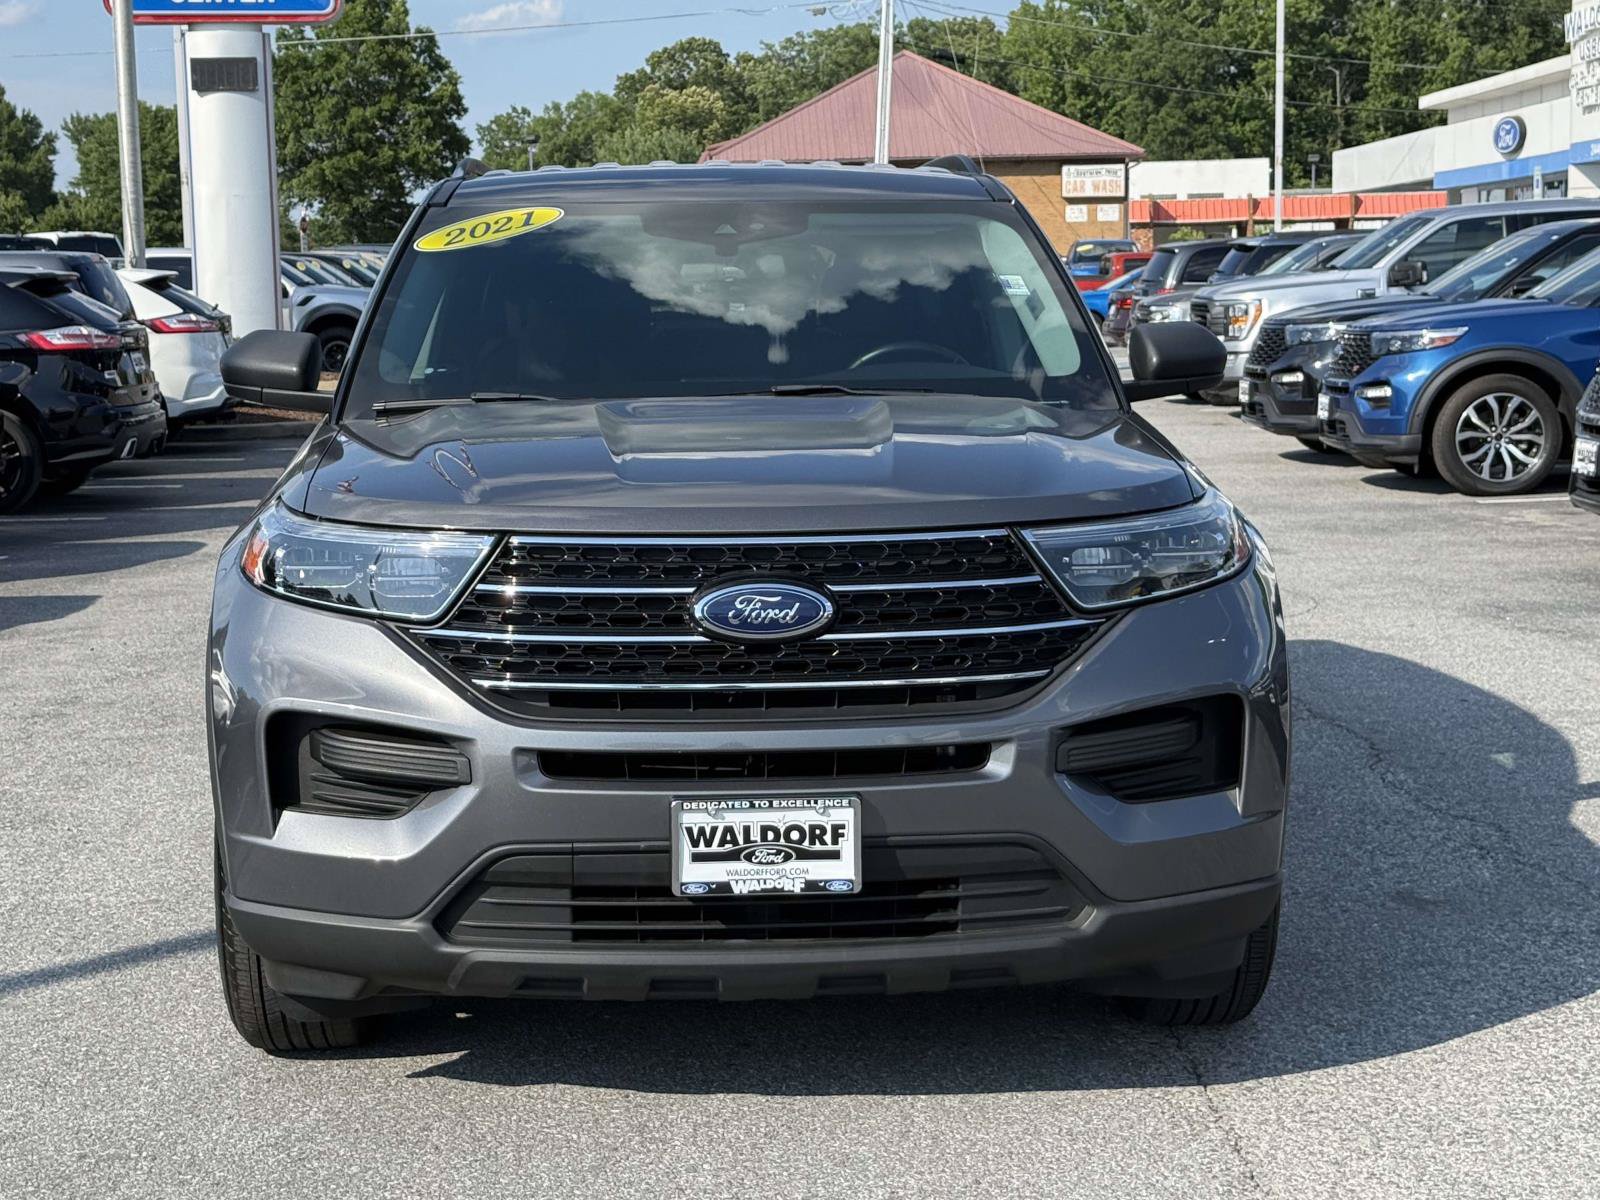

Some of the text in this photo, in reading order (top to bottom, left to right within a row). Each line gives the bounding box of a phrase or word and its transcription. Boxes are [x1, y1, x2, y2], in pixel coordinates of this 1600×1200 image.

[1498, 124, 1515, 148] Ford
[1065, 179, 1122, 194] CAR WASH
[443, 210, 536, 247] 2021
[728, 594, 800, 625] Ford
[683, 799, 850, 810] DEDICATED TO EXCELLENCE
[684, 822, 846, 849] WALDORF
[751, 849, 785, 864] Ford
[685, 883, 705, 893] Ford
[729, 877, 806, 894] WALDORF
[830, 881, 850, 891] Ford
